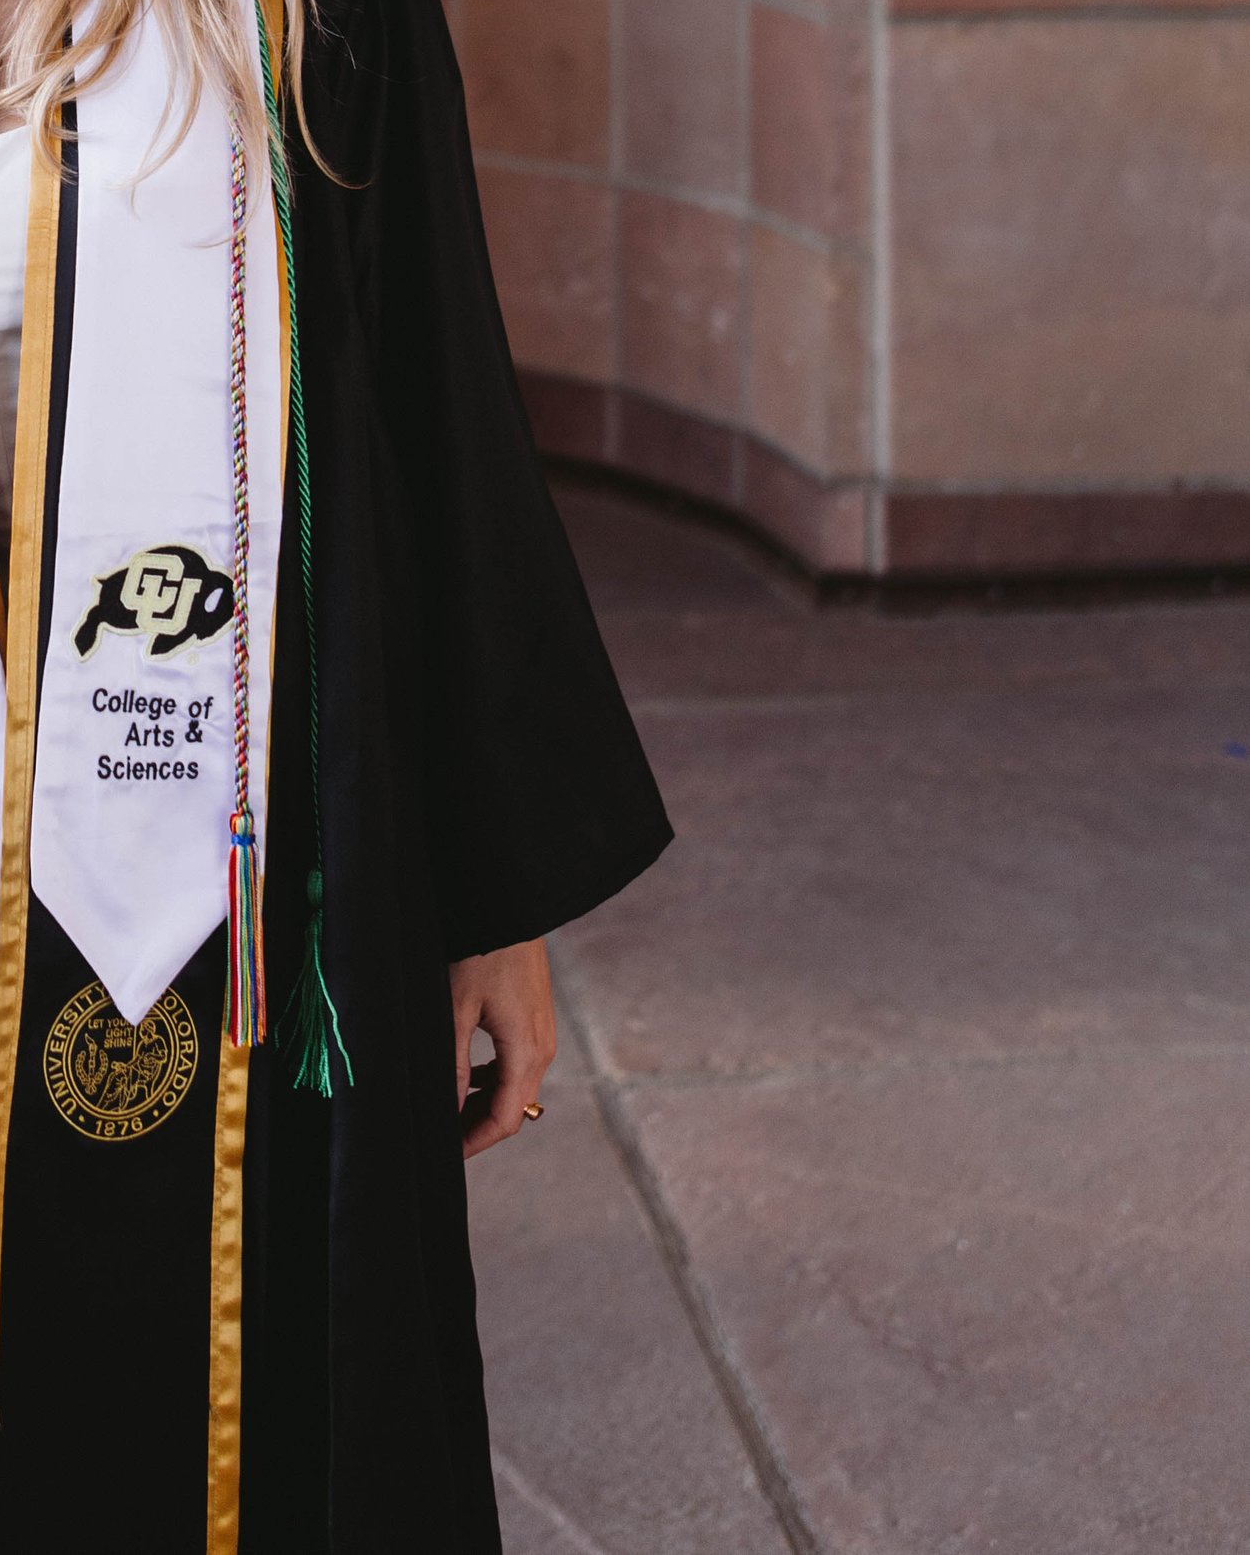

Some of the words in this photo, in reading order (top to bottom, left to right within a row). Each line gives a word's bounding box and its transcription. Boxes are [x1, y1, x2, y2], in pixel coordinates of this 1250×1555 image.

[92, 687, 177, 721] College
[188, 696, 214, 720] of
[124, 721, 175, 747] Arts
[185, 719, 203, 743] &
[97, 754, 200, 781] Sciences
[88, 1018, 104, 1029] LET
[105, 1026, 133, 1038] LIGHT
[103, 1037, 133, 1048] SHINE
[159, 995, 196, 1108] OLORADO
[94, 1117, 143, 1136] 1876
